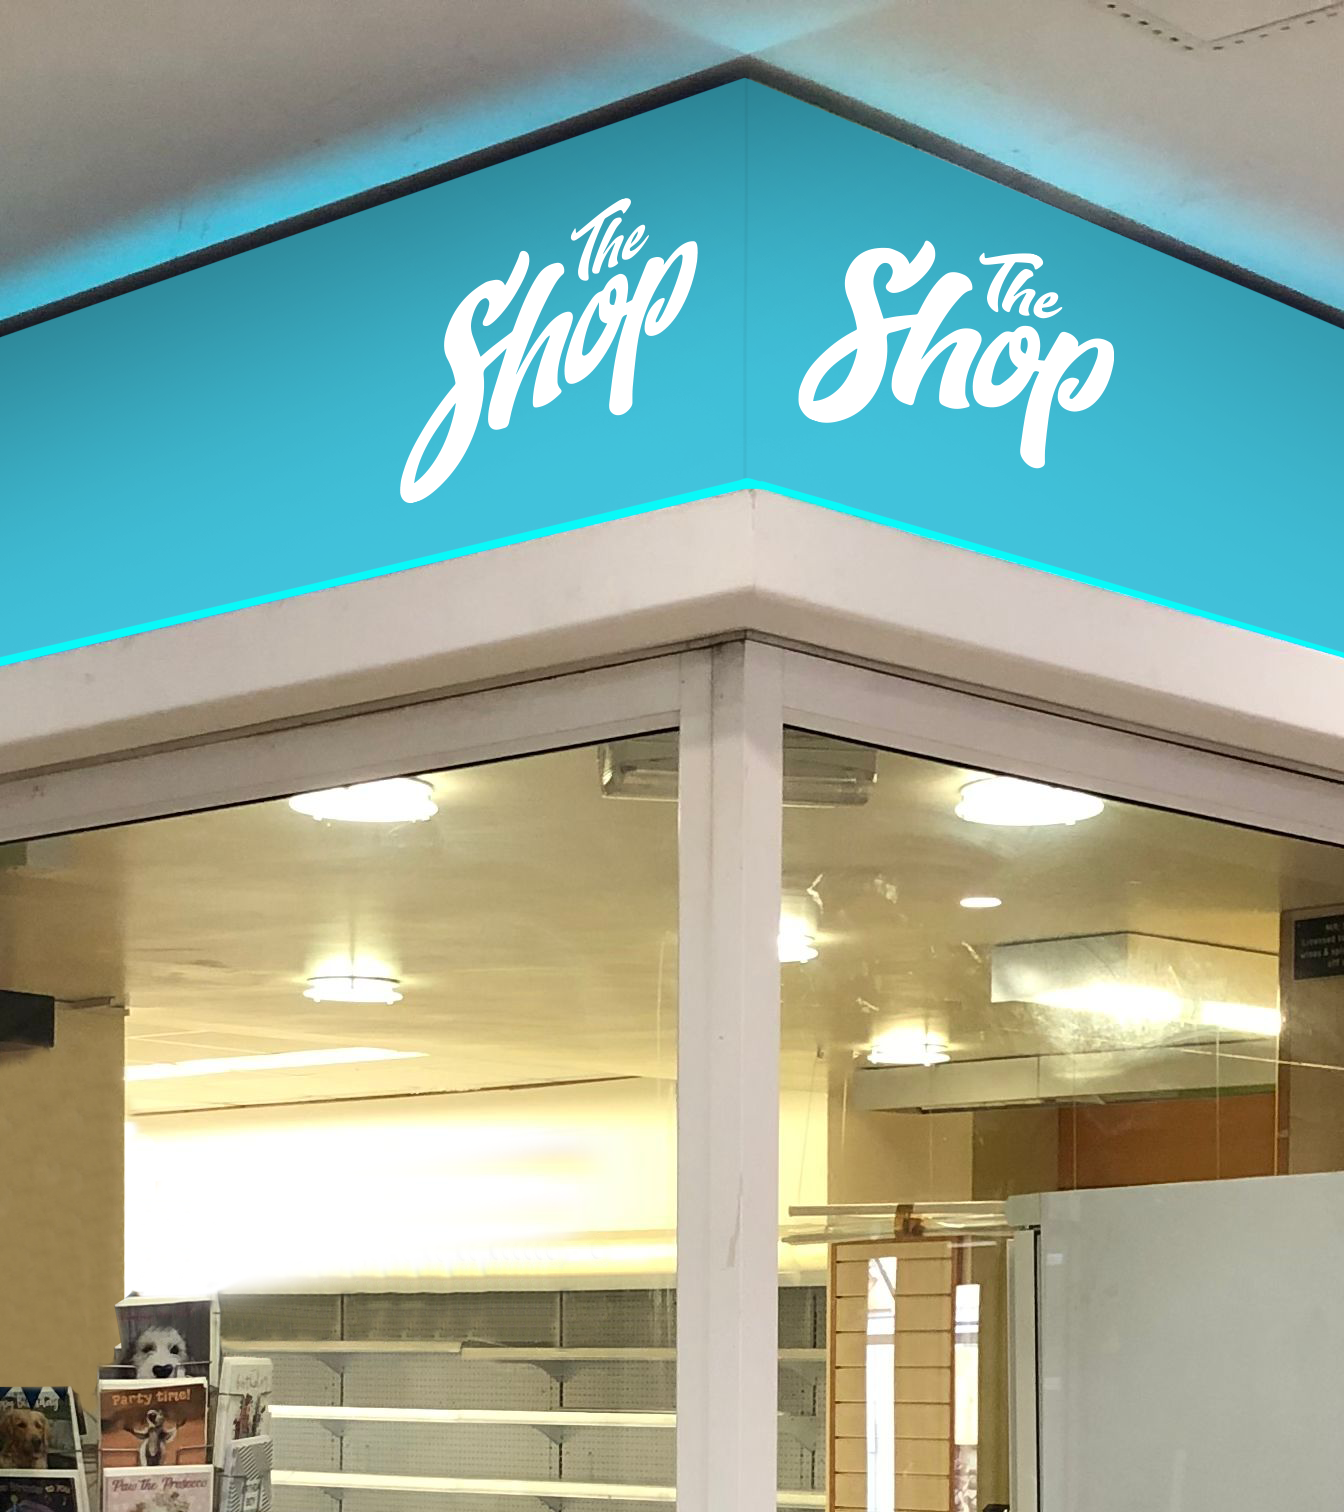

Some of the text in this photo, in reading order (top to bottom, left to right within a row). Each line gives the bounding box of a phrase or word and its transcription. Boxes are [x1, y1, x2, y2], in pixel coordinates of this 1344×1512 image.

[570, 197, 649, 281] The
[979, 252, 1062, 318] The
[400, 241, 699, 504] Shop
[798, 240, 1115, 469] Shop
[112, 1393, 153, 1406] Party
